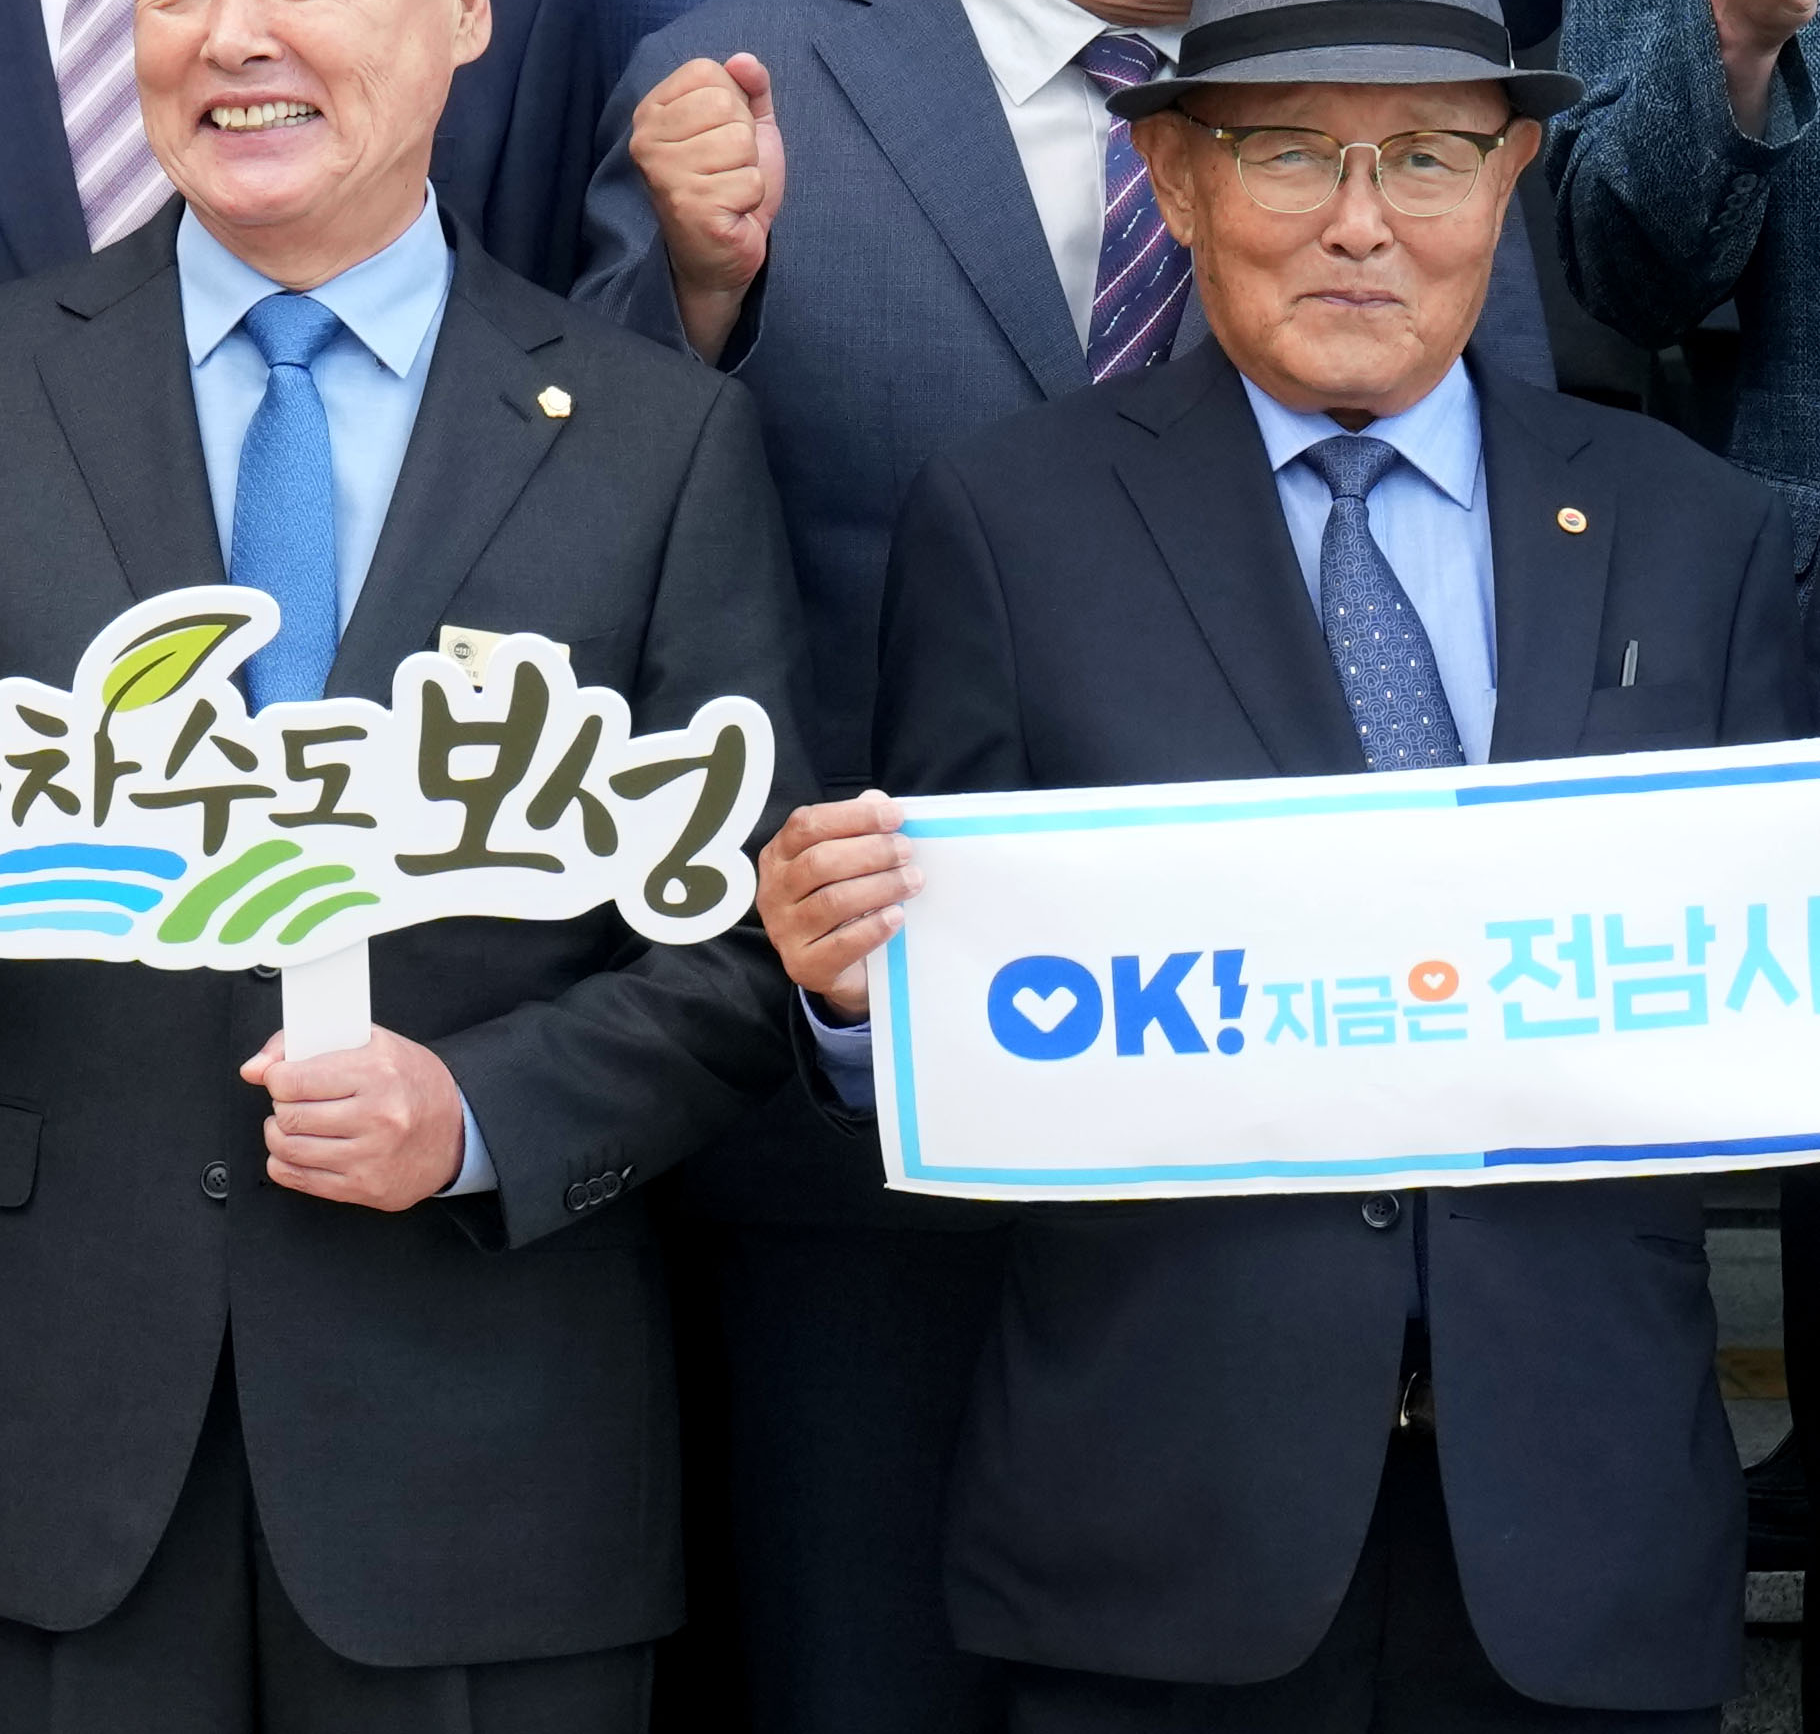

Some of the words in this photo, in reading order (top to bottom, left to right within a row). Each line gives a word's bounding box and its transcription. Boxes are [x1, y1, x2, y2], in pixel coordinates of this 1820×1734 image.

[395, 659, 747, 919] 보성
[986, 948, 1249, 1062] OK!
[1262, 959, 1469, 1049] 지금은
